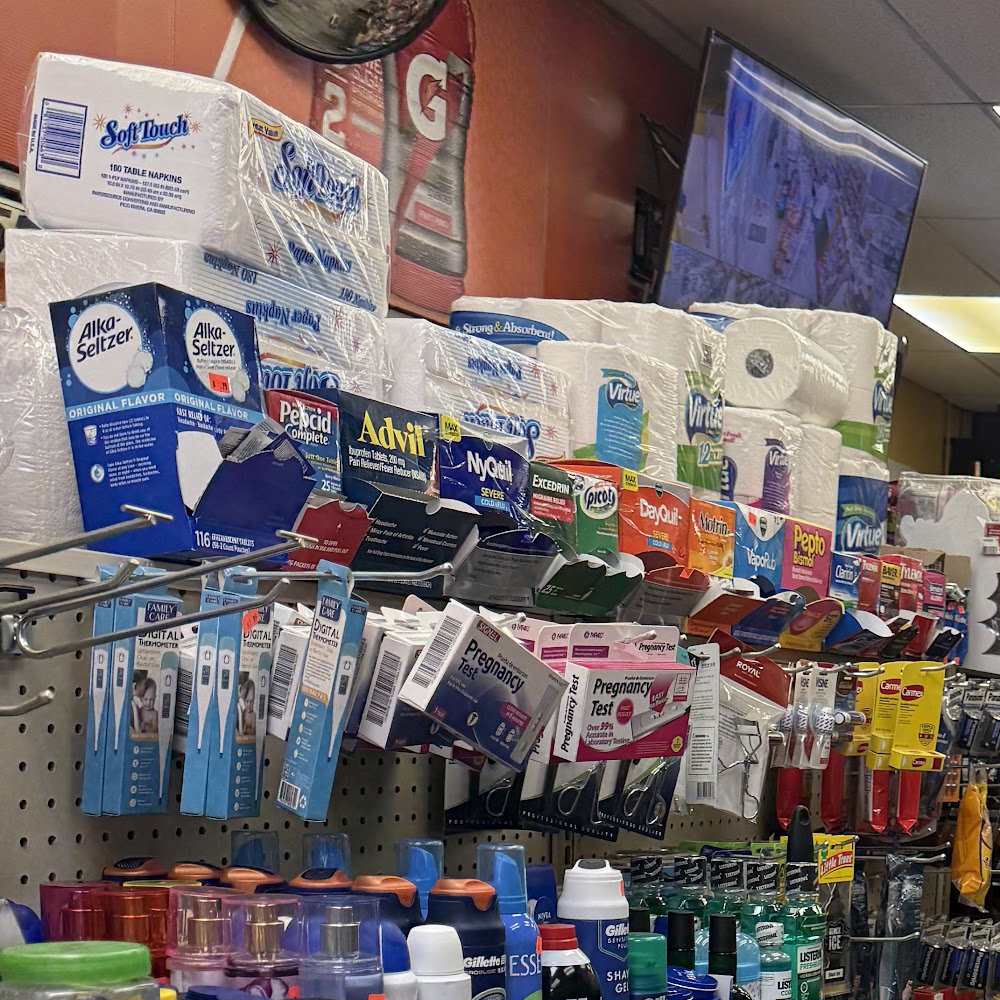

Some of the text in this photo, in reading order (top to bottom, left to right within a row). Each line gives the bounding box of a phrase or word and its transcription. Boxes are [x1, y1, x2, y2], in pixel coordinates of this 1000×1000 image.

[407, 54, 447, 141] G
[100, 114, 189, 149] Soft Touch
[124, 166, 147, 177] TABLE
[148, 170, 182, 184] NAPKINS
[78, 316, 121, 344] Alka-
[193, 322, 226, 341] Alka-
[463, 322, 493, 336] Strong
[503, 323, 556, 340] Absorbent!
[76, 326, 133, 362] Seltzer
[192, 340, 235, 357] Seltzer
[607, 382, 641, 404] Virtue
[68, 393, 165, 419] ORIGINAL FLAVOR
[174, 393, 249, 420] ORIGINAL FLAVOR
[688, 398, 723, 429] Virtue
[285, 424, 329, 446] Complete
[357, 410, 426, 458] Advil
[444, 421, 459, 433] MAX
[349, 445, 371, 459] Ibuprofen
[388, 453, 398, 465] 200
[349, 455, 361, 467] Pain
[467, 451, 512, 485] NyQuil
[321, 480, 330, 492] 25
[532, 474, 571, 494] EXCEDRIN
[625, 474, 637, 484] MAX
[481, 487, 505, 500] SEVERE
[639, 499, 678, 525] DayQuil
[699, 513, 727, 535] Motrin
[195, 531, 211, 548] 116
[793, 525, 825, 556] Pepto
[845, 523, 882, 548] Virtue
[747, 550, 777, 571] VapoRub
[793, 551, 815, 568] Bismol
[147, 603, 175, 613] FAMILY
[321, 597, 341, 610] FAMILY
[321, 607, 336, 619] CARE
[149, 612, 171, 622] CARE
[139, 630, 179, 641] DIGITAL
[314, 618, 340, 639] DIGITAL
[138, 638, 178, 649] THERMOMETER
[639, 643, 676, 652] Pregnancy Test
[458, 658, 479, 681] Test
[464, 639, 525, 694] Pregnancy
[736, 660, 760, 678] ROYAL
[593, 678, 652, 698] Pregnancy
[881, 681, 901, 692] Carme
[901, 686, 924, 698] Carmex
[560, 675, 580, 753] Pregnancy Test
[591, 700, 613, 716] Test
[586, 731, 607, 739] Accurate
[820, 853, 852, 875] Little Trees
[538, 911, 552, 920] NIVEA
[463, 955, 501, 969] Gillette
